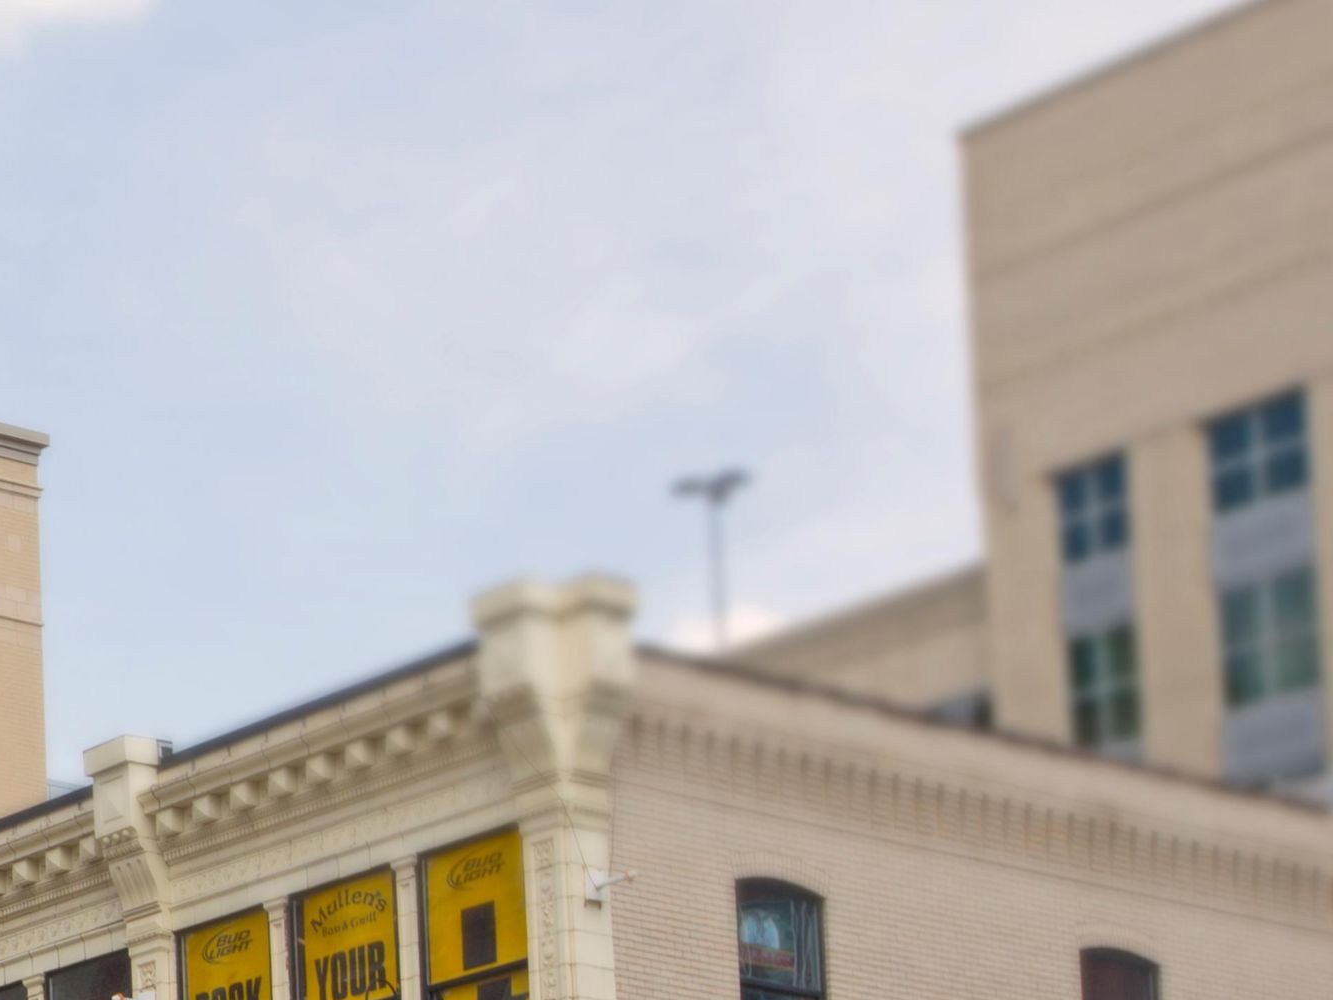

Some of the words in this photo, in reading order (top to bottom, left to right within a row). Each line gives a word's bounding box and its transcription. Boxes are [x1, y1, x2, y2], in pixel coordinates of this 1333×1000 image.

[310, 889, 387, 933] Mullen's
[206, 938, 253, 959] LIGHT
[217, 929, 250, 947] BUD
